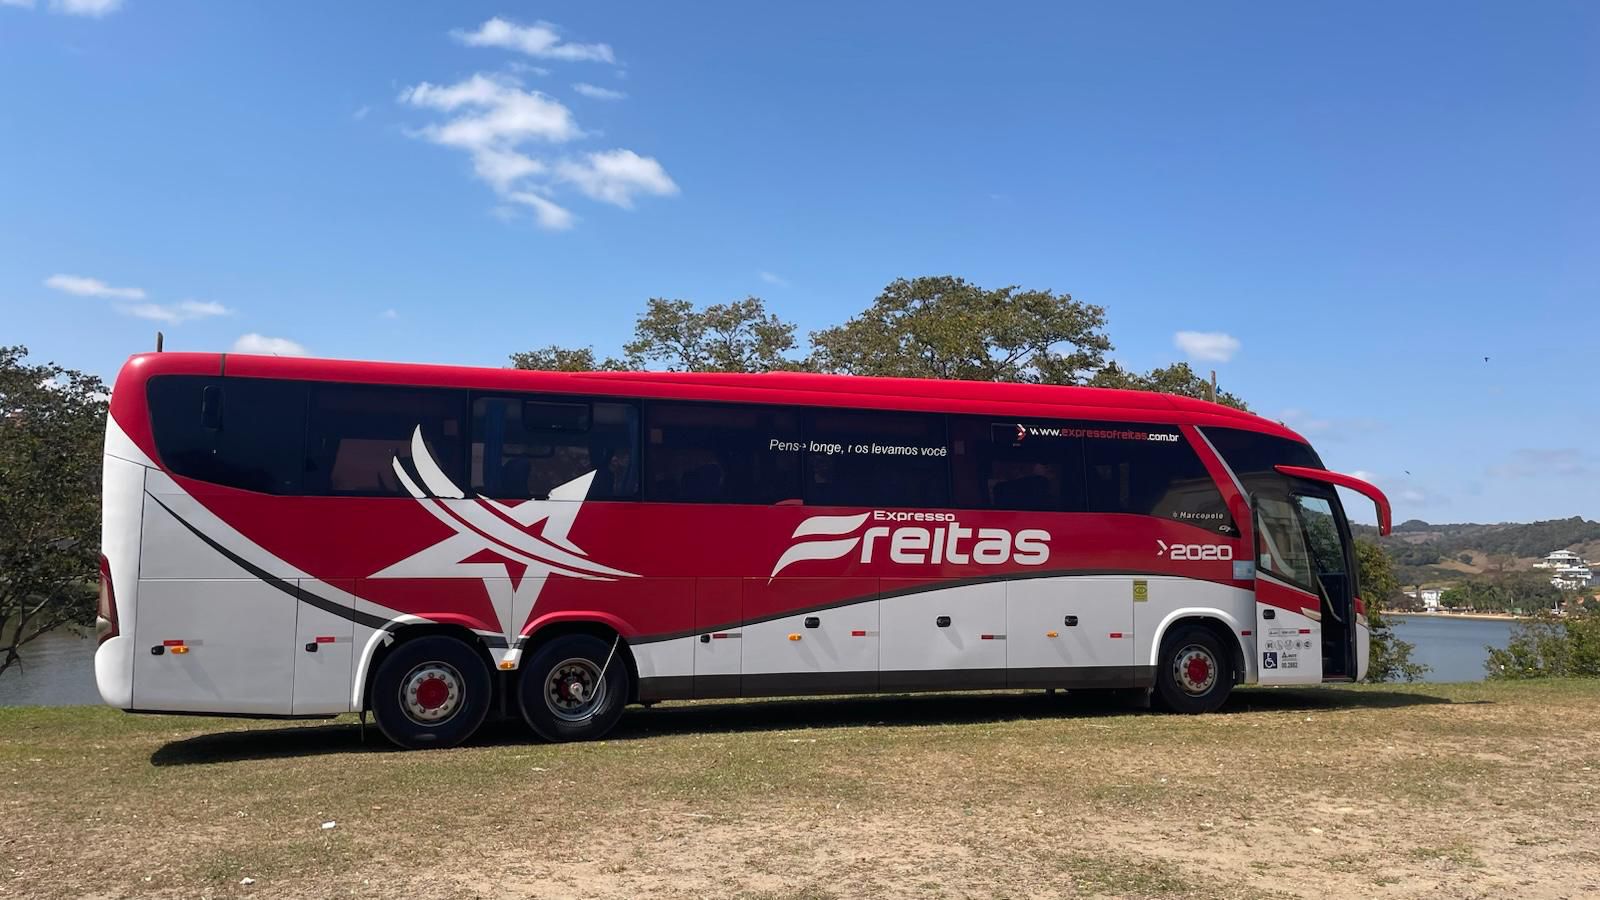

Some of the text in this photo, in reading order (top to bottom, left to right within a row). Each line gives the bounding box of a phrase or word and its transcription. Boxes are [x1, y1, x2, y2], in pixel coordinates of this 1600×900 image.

[1029, 427, 1180, 442] www.expressofreitas.com.br
[809, 440, 845, 455] longe,
[871, 443, 918, 455] levamos
[921, 446, 947, 457] você
[873, 510, 956, 522] Expresso
[1179, 511, 1224, 520] Marcopolo
[1170, 544, 1233, 560] 2020
